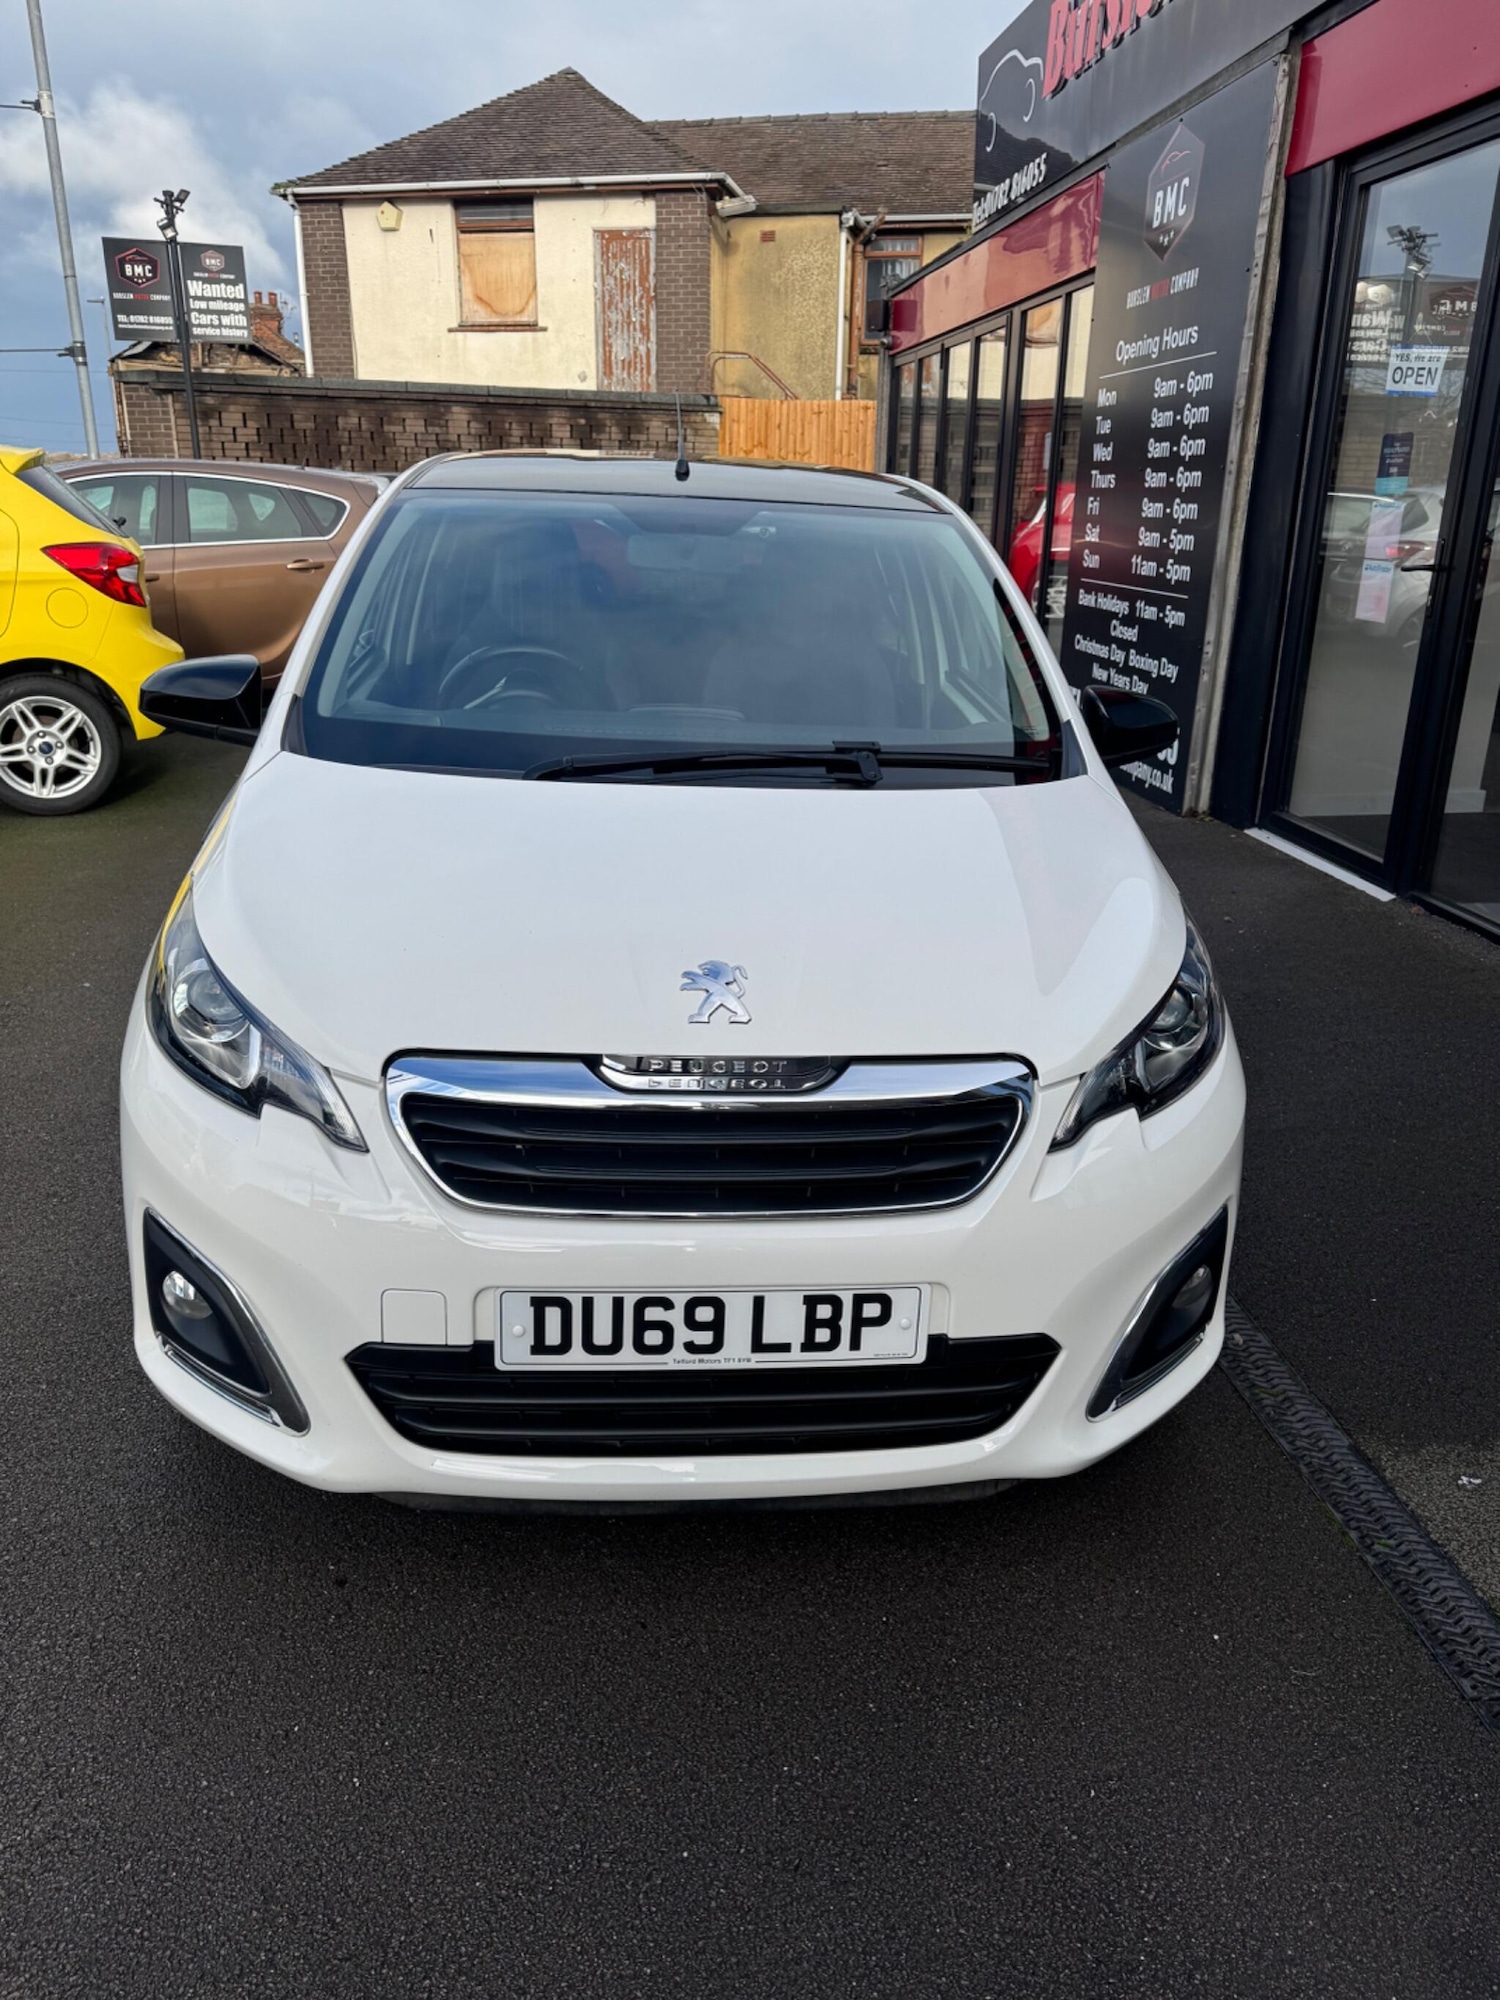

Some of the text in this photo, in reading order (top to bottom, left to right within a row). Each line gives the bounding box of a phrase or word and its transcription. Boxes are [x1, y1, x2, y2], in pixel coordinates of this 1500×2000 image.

[1152, 176, 1190, 229] BMC
[124, 264, 153, 277] BMC
[186, 279, 245, 300] Wanted
[189, 298, 245, 312] Low mileage
[190, 312, 247, 327] Cars with
[192, 326, 248, 338] service history
[1115, 325, 1199, 366] Opening Hours
[1427, 355, 1442, 363] are
[1097, 388, 1117, 408] Mon
[1153, 377, 1178, 398] 9am
[1186, 371, 1214, 398] 6pm
[1392, 366, 1438, 386] OPEN
[1096, 416, 1112, 435] Tue
[1150, 407, 1174, 429] 9am
[1183, 403, 1210, 430] 6pm
[1093, 441, 1113, 462] Wed
[1147, 438, 1170, 459] 9am
[1179, 434, 1206, 462] 6pm
[1090, 469, 1116, 489] Thurs
[1144, 467, 1167, 488] 9am
[1176, 466, 1202, 493] 6pm
[1087, 496, 1100, 516] Fri
[1141, 497, 1164, 518] 9am
[1172, 497, 1198, 524] 6pm
[1085, 523, 1100, 543] Sat
[1138, 526, 1160, 548] 9am
[1169, 528, 1195, 555] 5pm
[1082, 549, 1100, 569] Sun
[1131, 554, 1157, 577] 11am
[1165, 559, 1191, 585] 5pm
[1078, 589, 1097, 608] Bank
[1097, 591, 1129, 618] Holidays
[1135, 599, 1157, 622] 11am
[1164, 605, 1186, 629] 5pm
[1110, 619, 1139, 642] Closed
[1074, 634, 1179, 684] Christmas Day Boxing Day
[1092, 661, 1108, 682] New
[1110, 668, 1131, 691] Years
[648, 1059, 787, 1073] PEUGEOT
[529, 1293, 893, 1356] DU69 LBP
